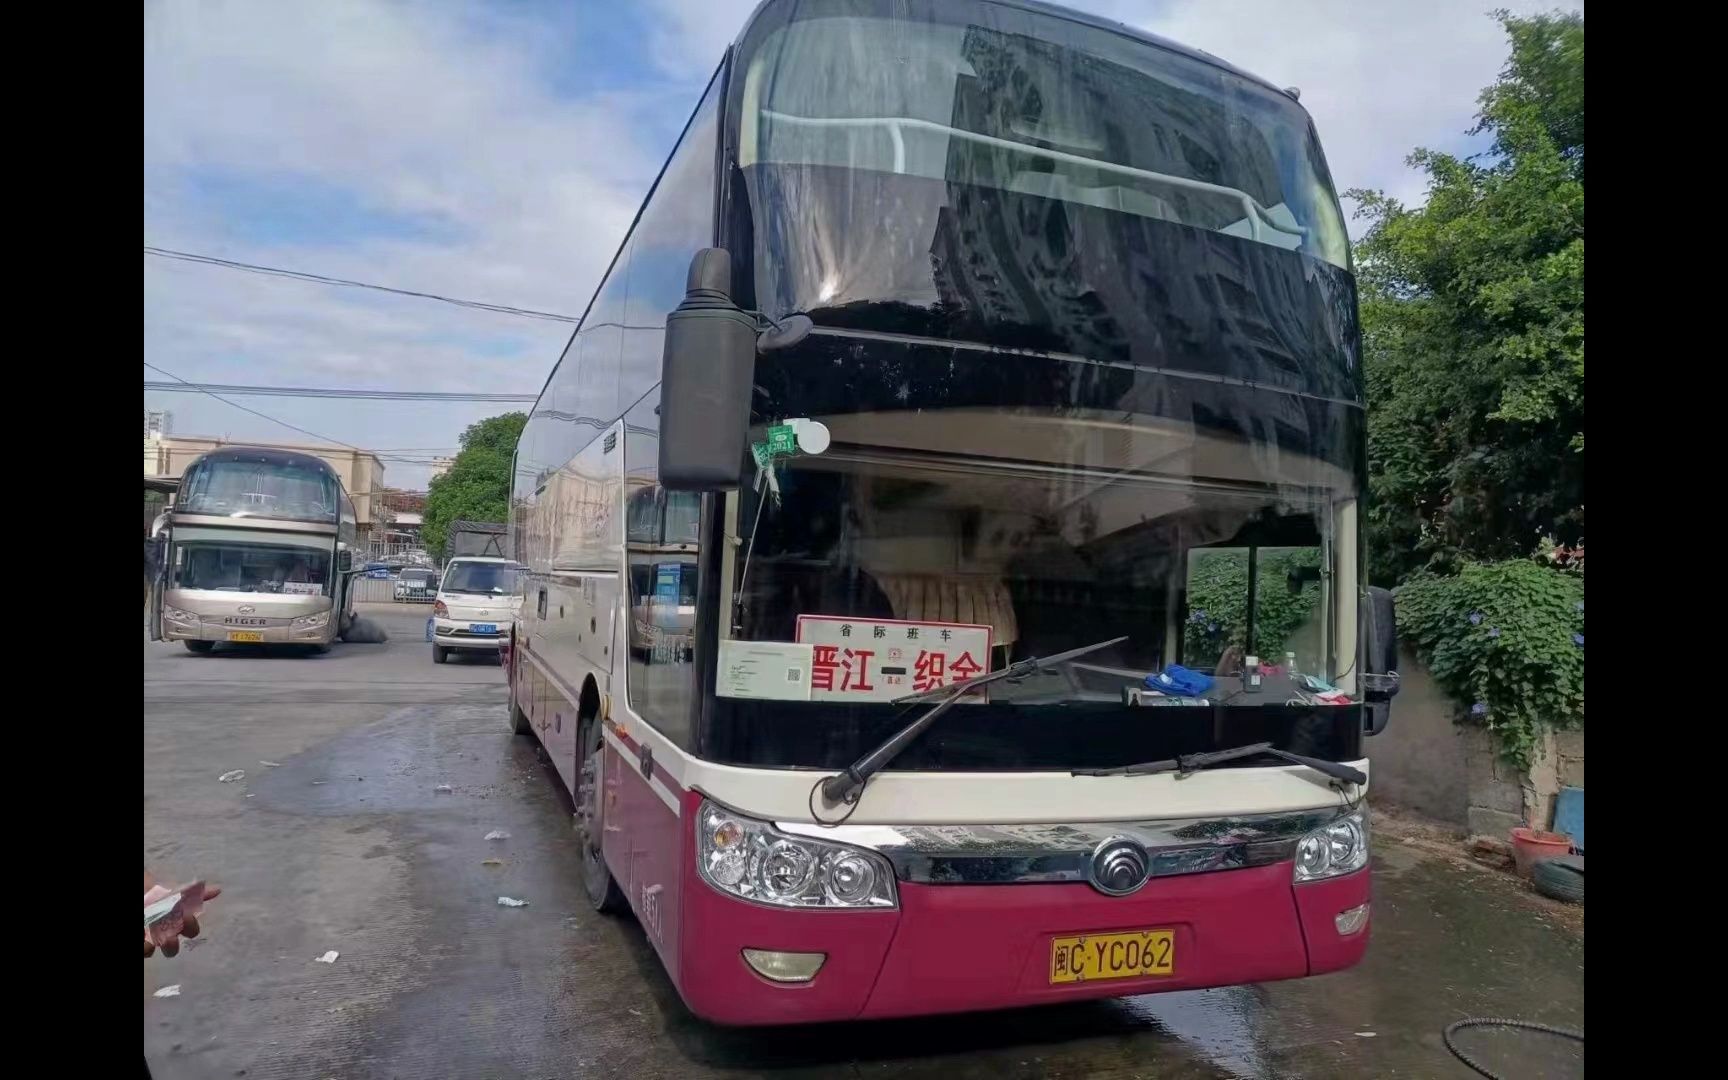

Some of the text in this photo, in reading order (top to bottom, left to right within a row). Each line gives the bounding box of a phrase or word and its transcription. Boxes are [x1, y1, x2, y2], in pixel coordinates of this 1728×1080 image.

[224, 616, 267, 625] HIGER
[840, 623, 952, 643] 省际班车
[811, 645, 875, 692] 晋江
